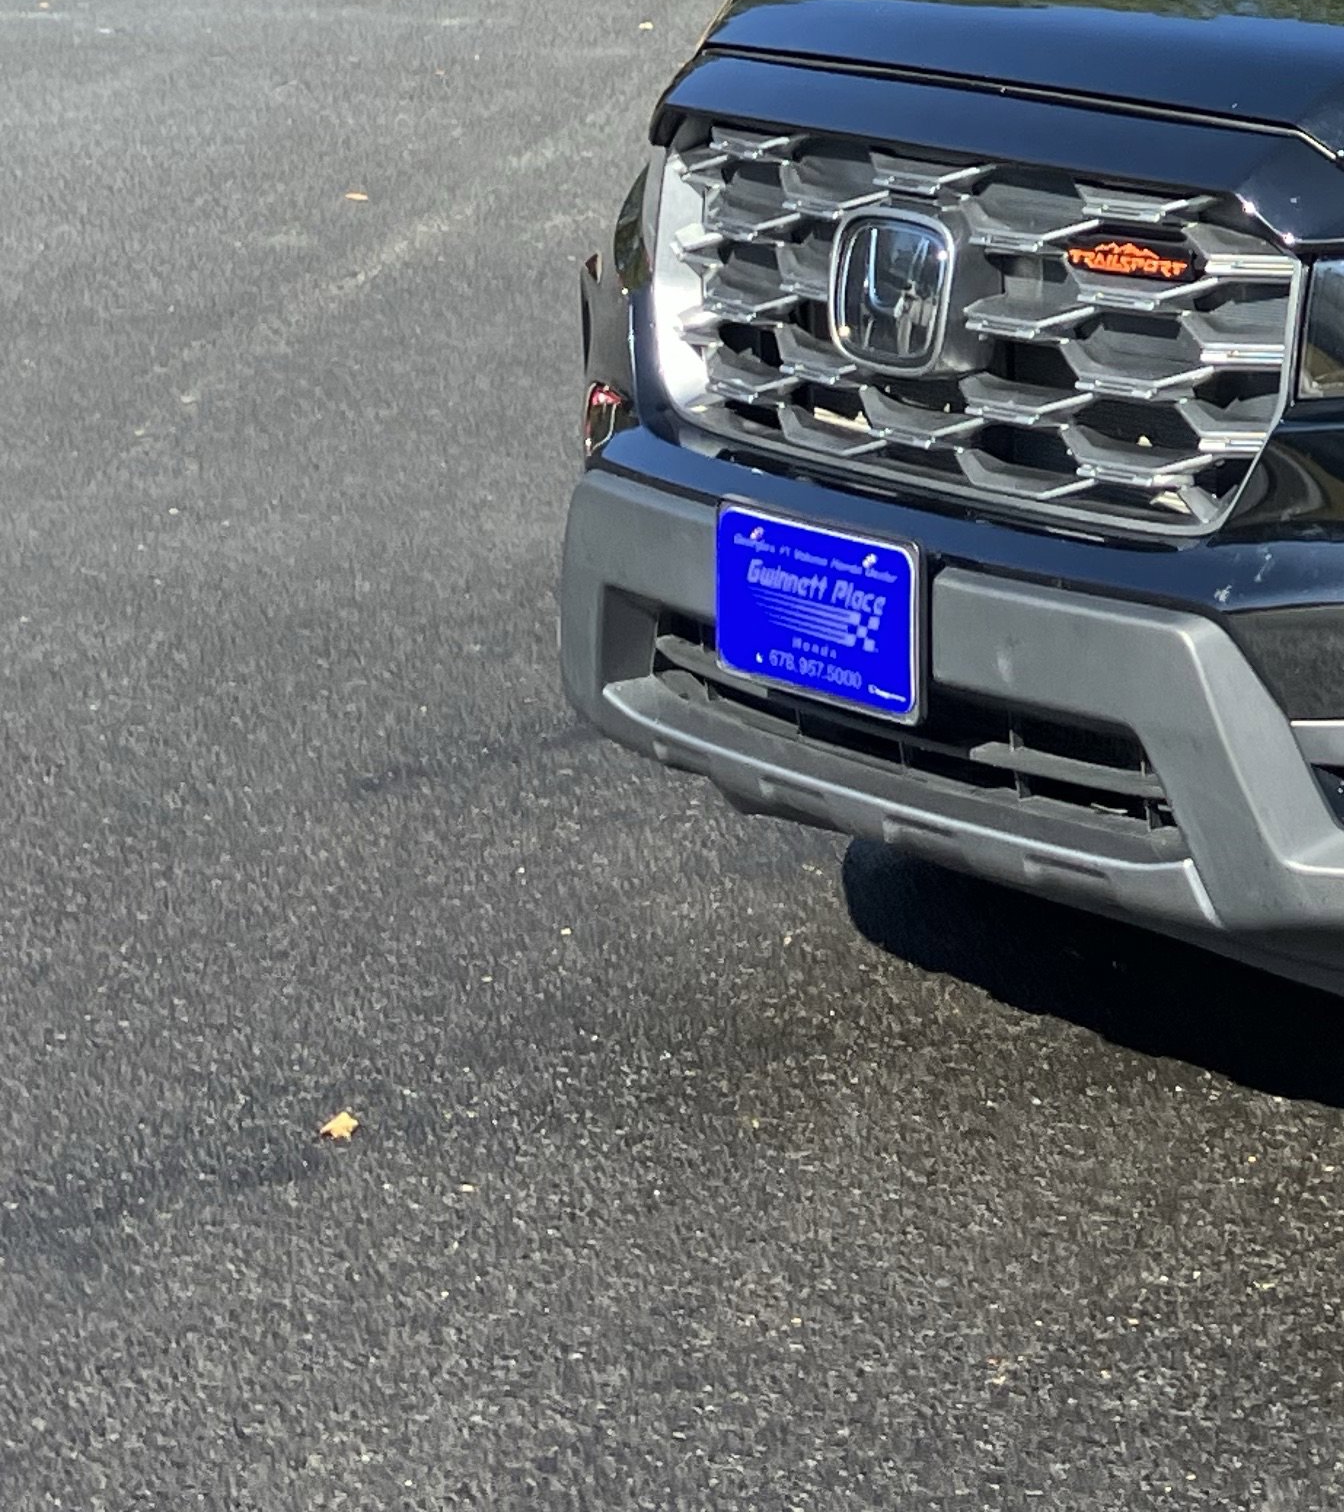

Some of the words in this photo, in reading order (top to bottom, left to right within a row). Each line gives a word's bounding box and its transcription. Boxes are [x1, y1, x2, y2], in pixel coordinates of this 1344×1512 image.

[1069, 249, 1187, 277] TRAILSPORT
[747, 558, 828, 600] Gwinnett
[831, 579, 887, 616] Place
[792, 637, 837, 659] Honda
